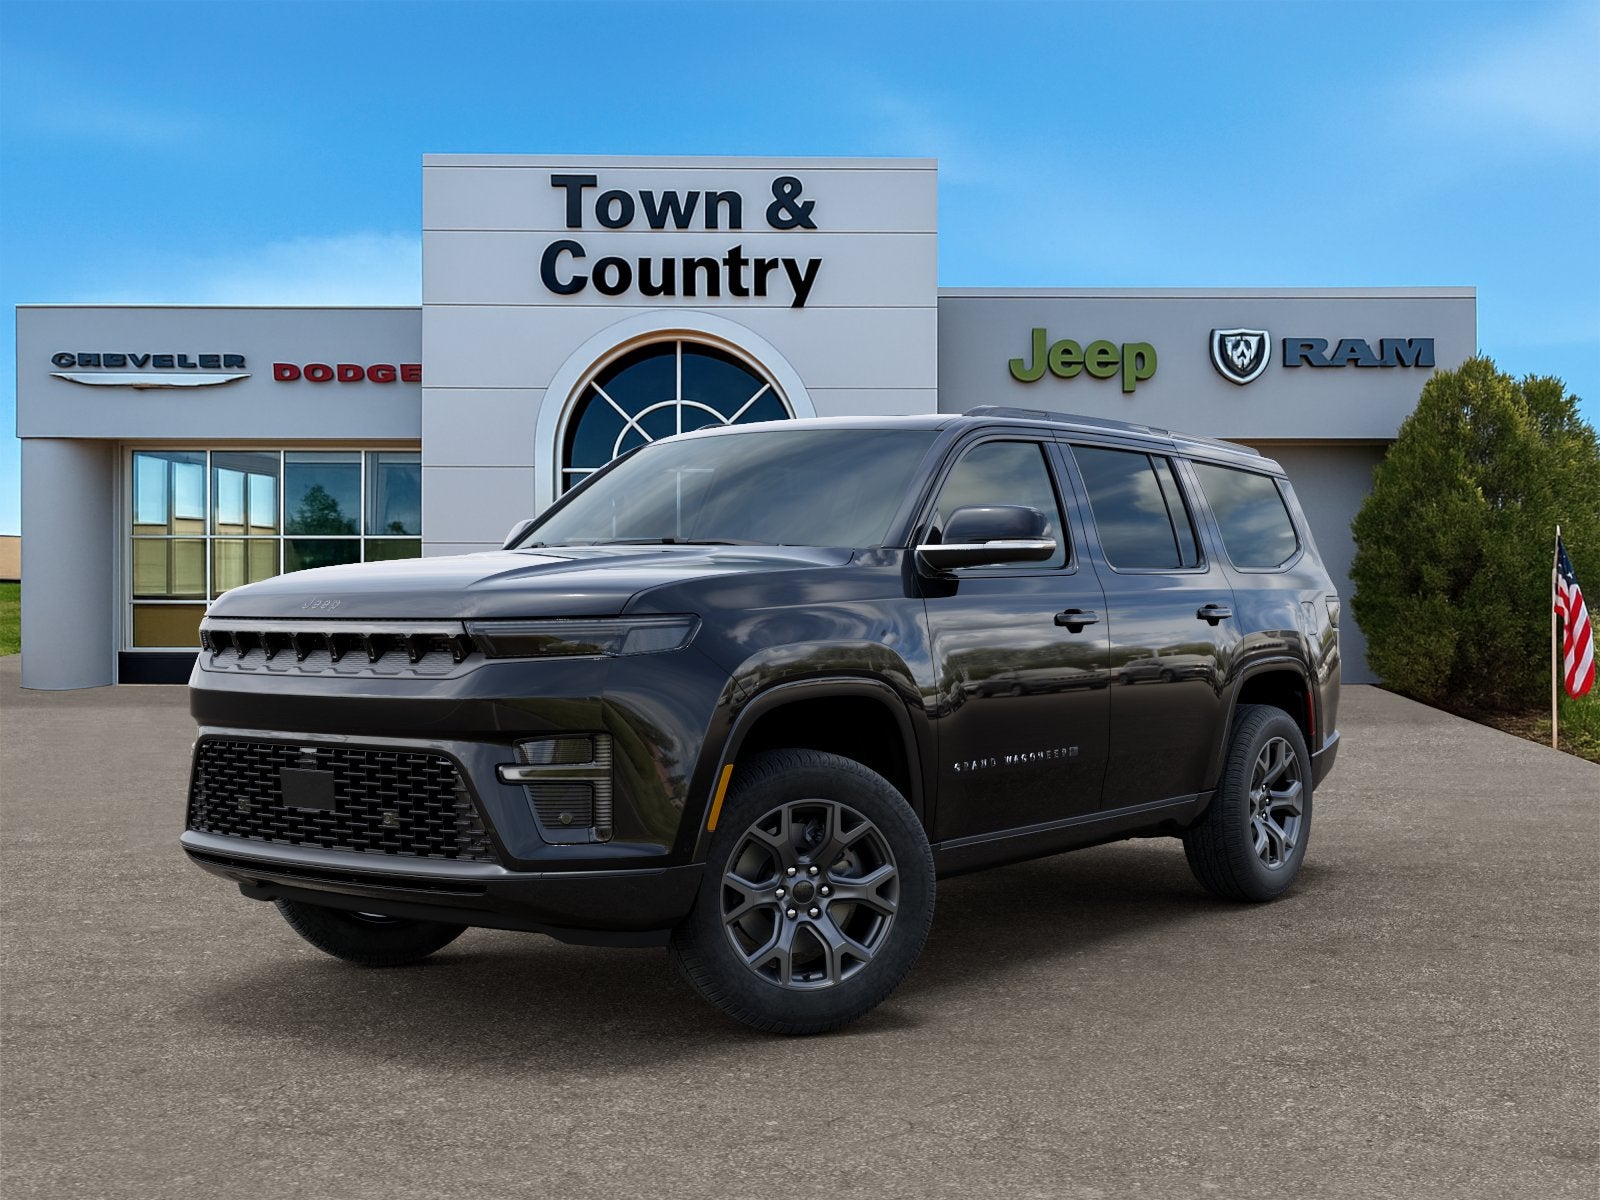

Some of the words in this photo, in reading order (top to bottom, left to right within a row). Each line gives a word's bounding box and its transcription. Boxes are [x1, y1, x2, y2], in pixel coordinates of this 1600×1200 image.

[550, 174, 742, 229] Town
[766, 176, 818, 230] &
[540, 239, 822, 308] Country
[273, 362, 422, 383] DODGE
[1009, 328, 1158, 392] Jeep
[1283, 337, 1435, 368] RAM
